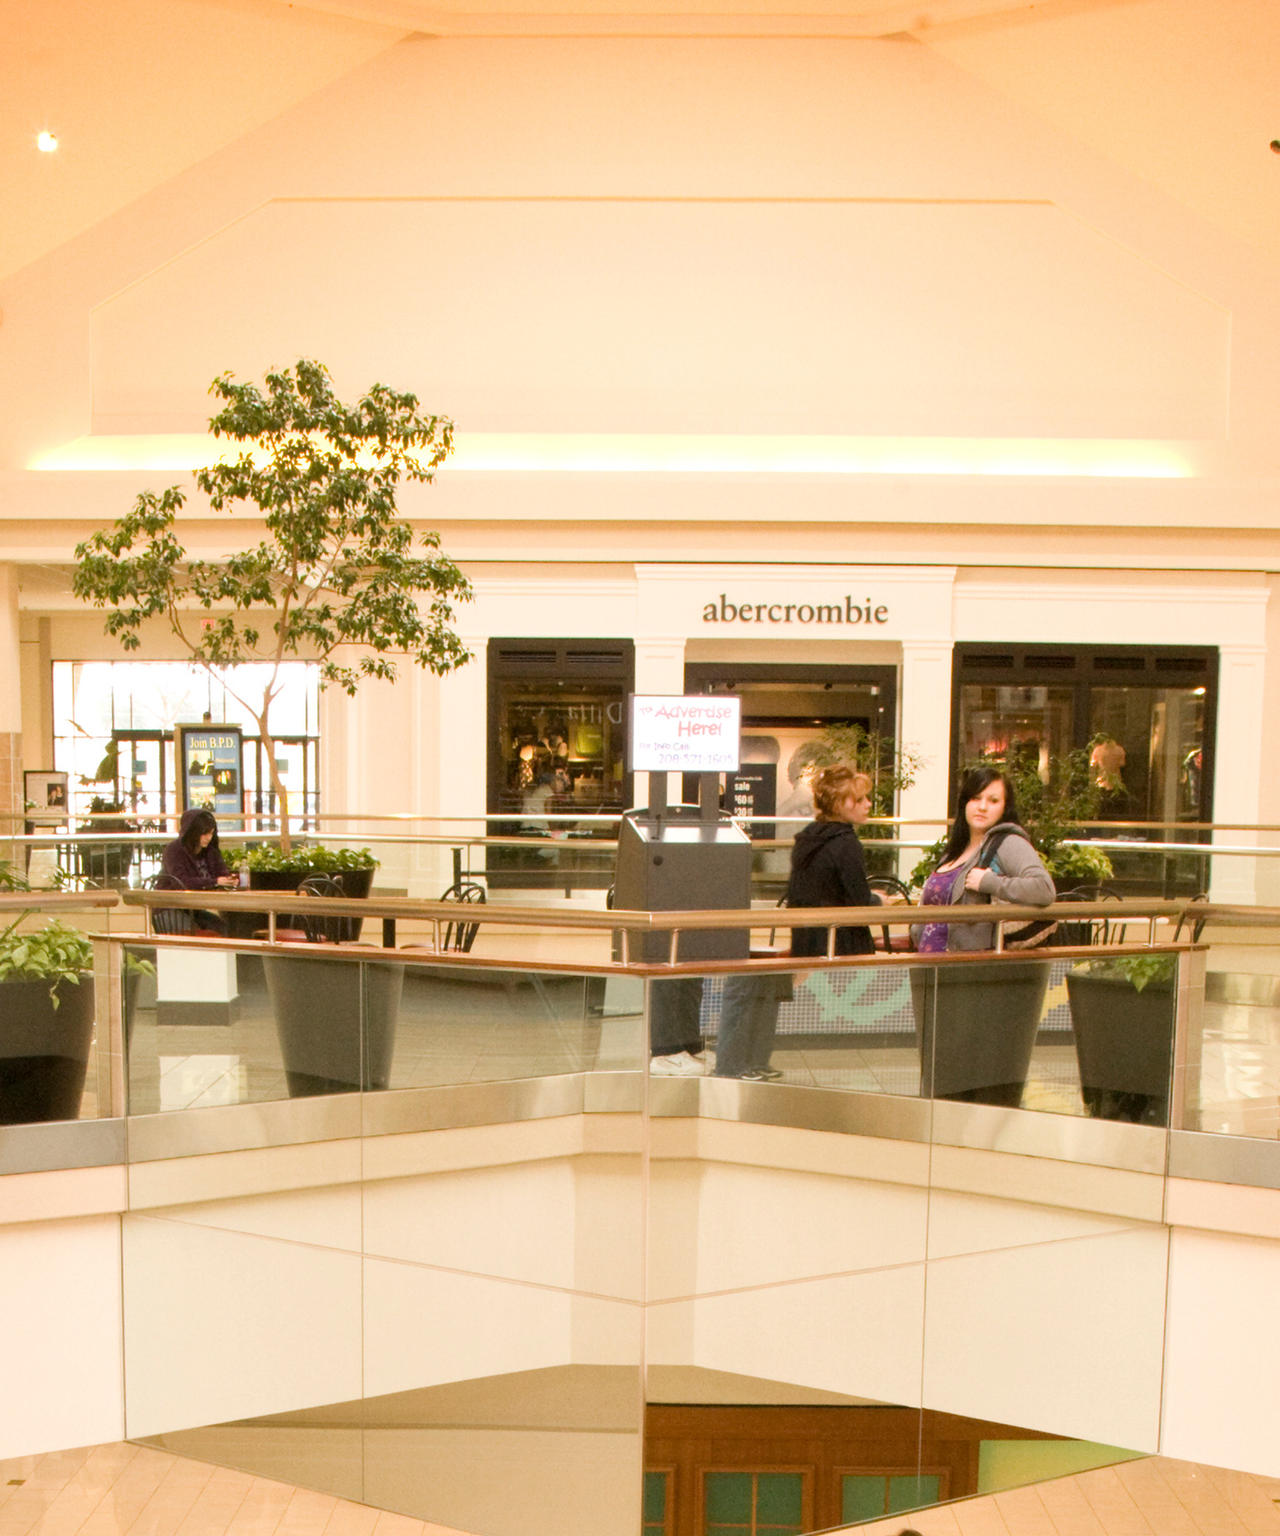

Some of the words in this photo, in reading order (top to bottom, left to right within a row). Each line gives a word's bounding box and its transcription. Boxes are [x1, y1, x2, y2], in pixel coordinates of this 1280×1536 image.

[702, 593, 889, 624] abercrombie
[190, 737, 207, 748] Join
[209, 737, 235, 748] B.P.D.
[734, 781, 751, 792] sale
